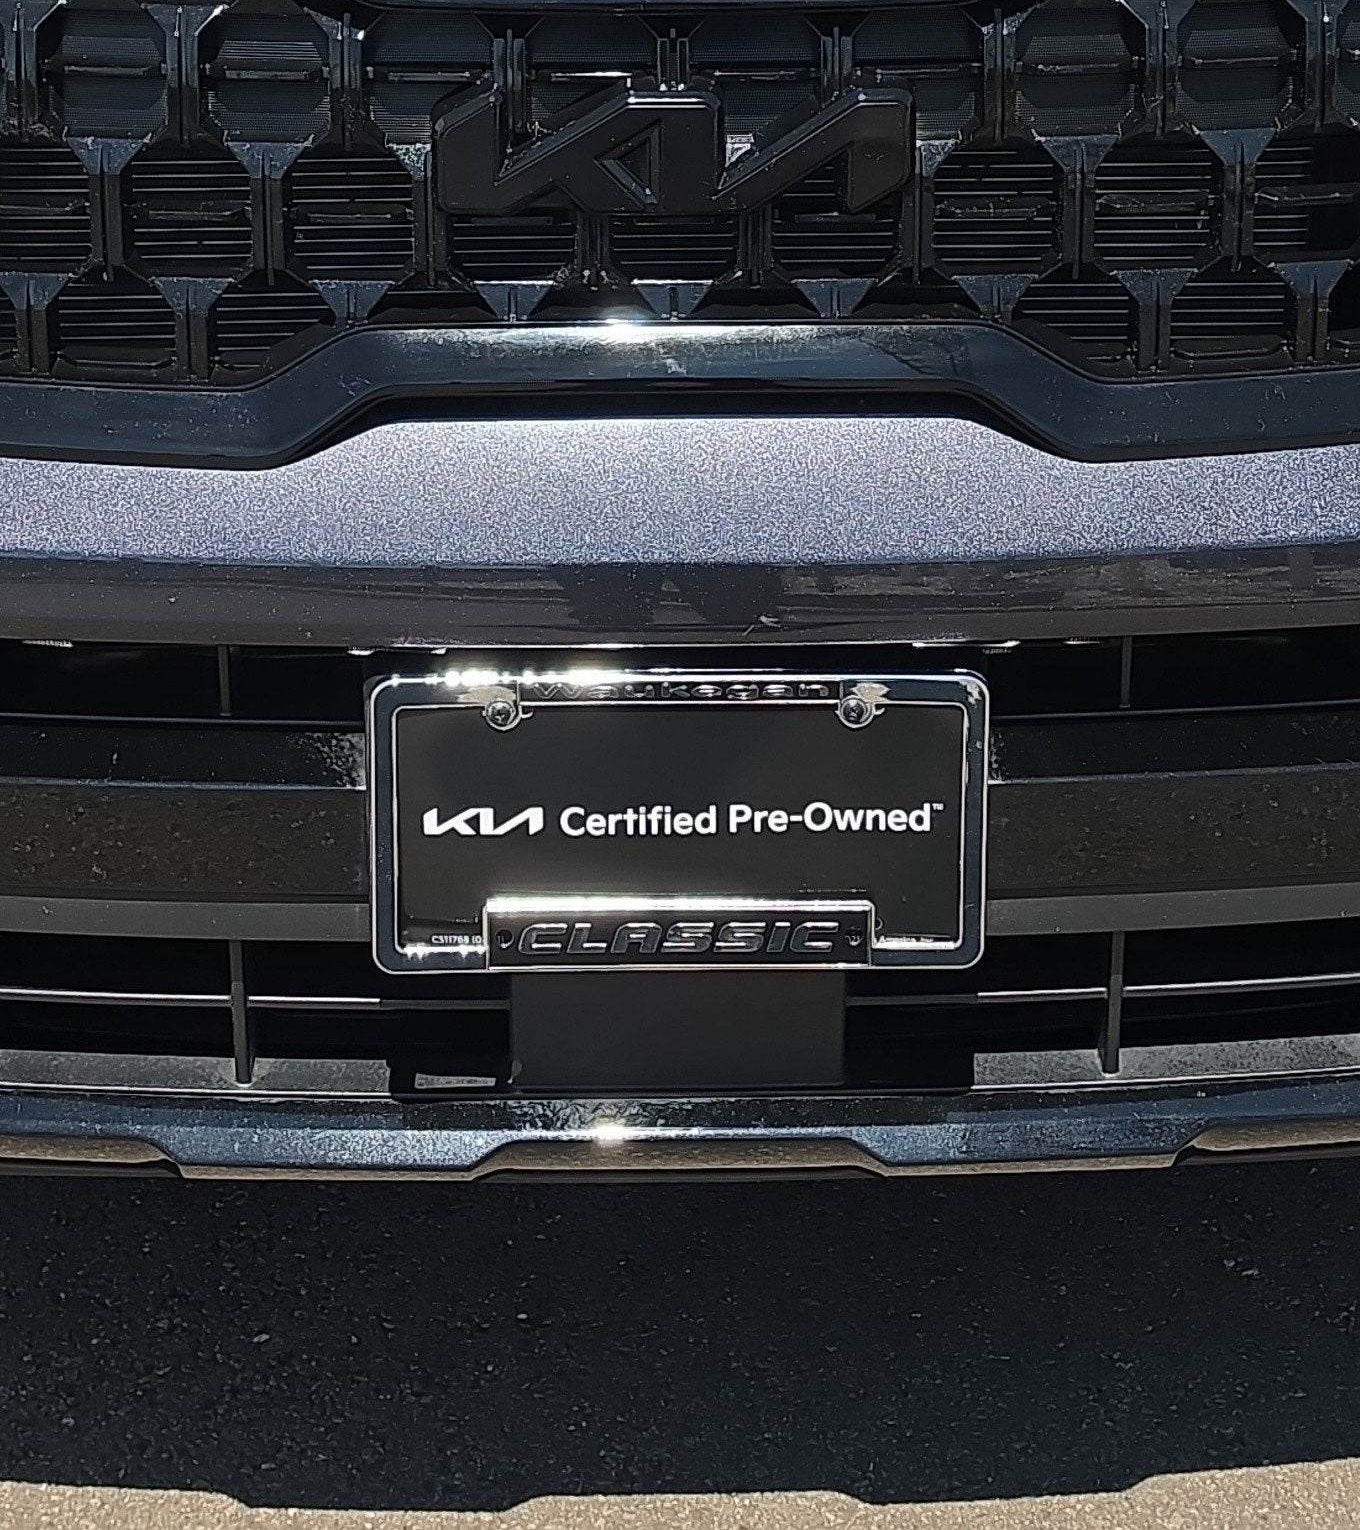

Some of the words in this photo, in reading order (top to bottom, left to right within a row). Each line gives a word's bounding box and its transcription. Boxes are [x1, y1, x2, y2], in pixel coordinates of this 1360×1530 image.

[423, 807, 544, 836] KIA
[559, 805, 717, 837] Certified
[518, 921, 839, 955] CLASSIC
